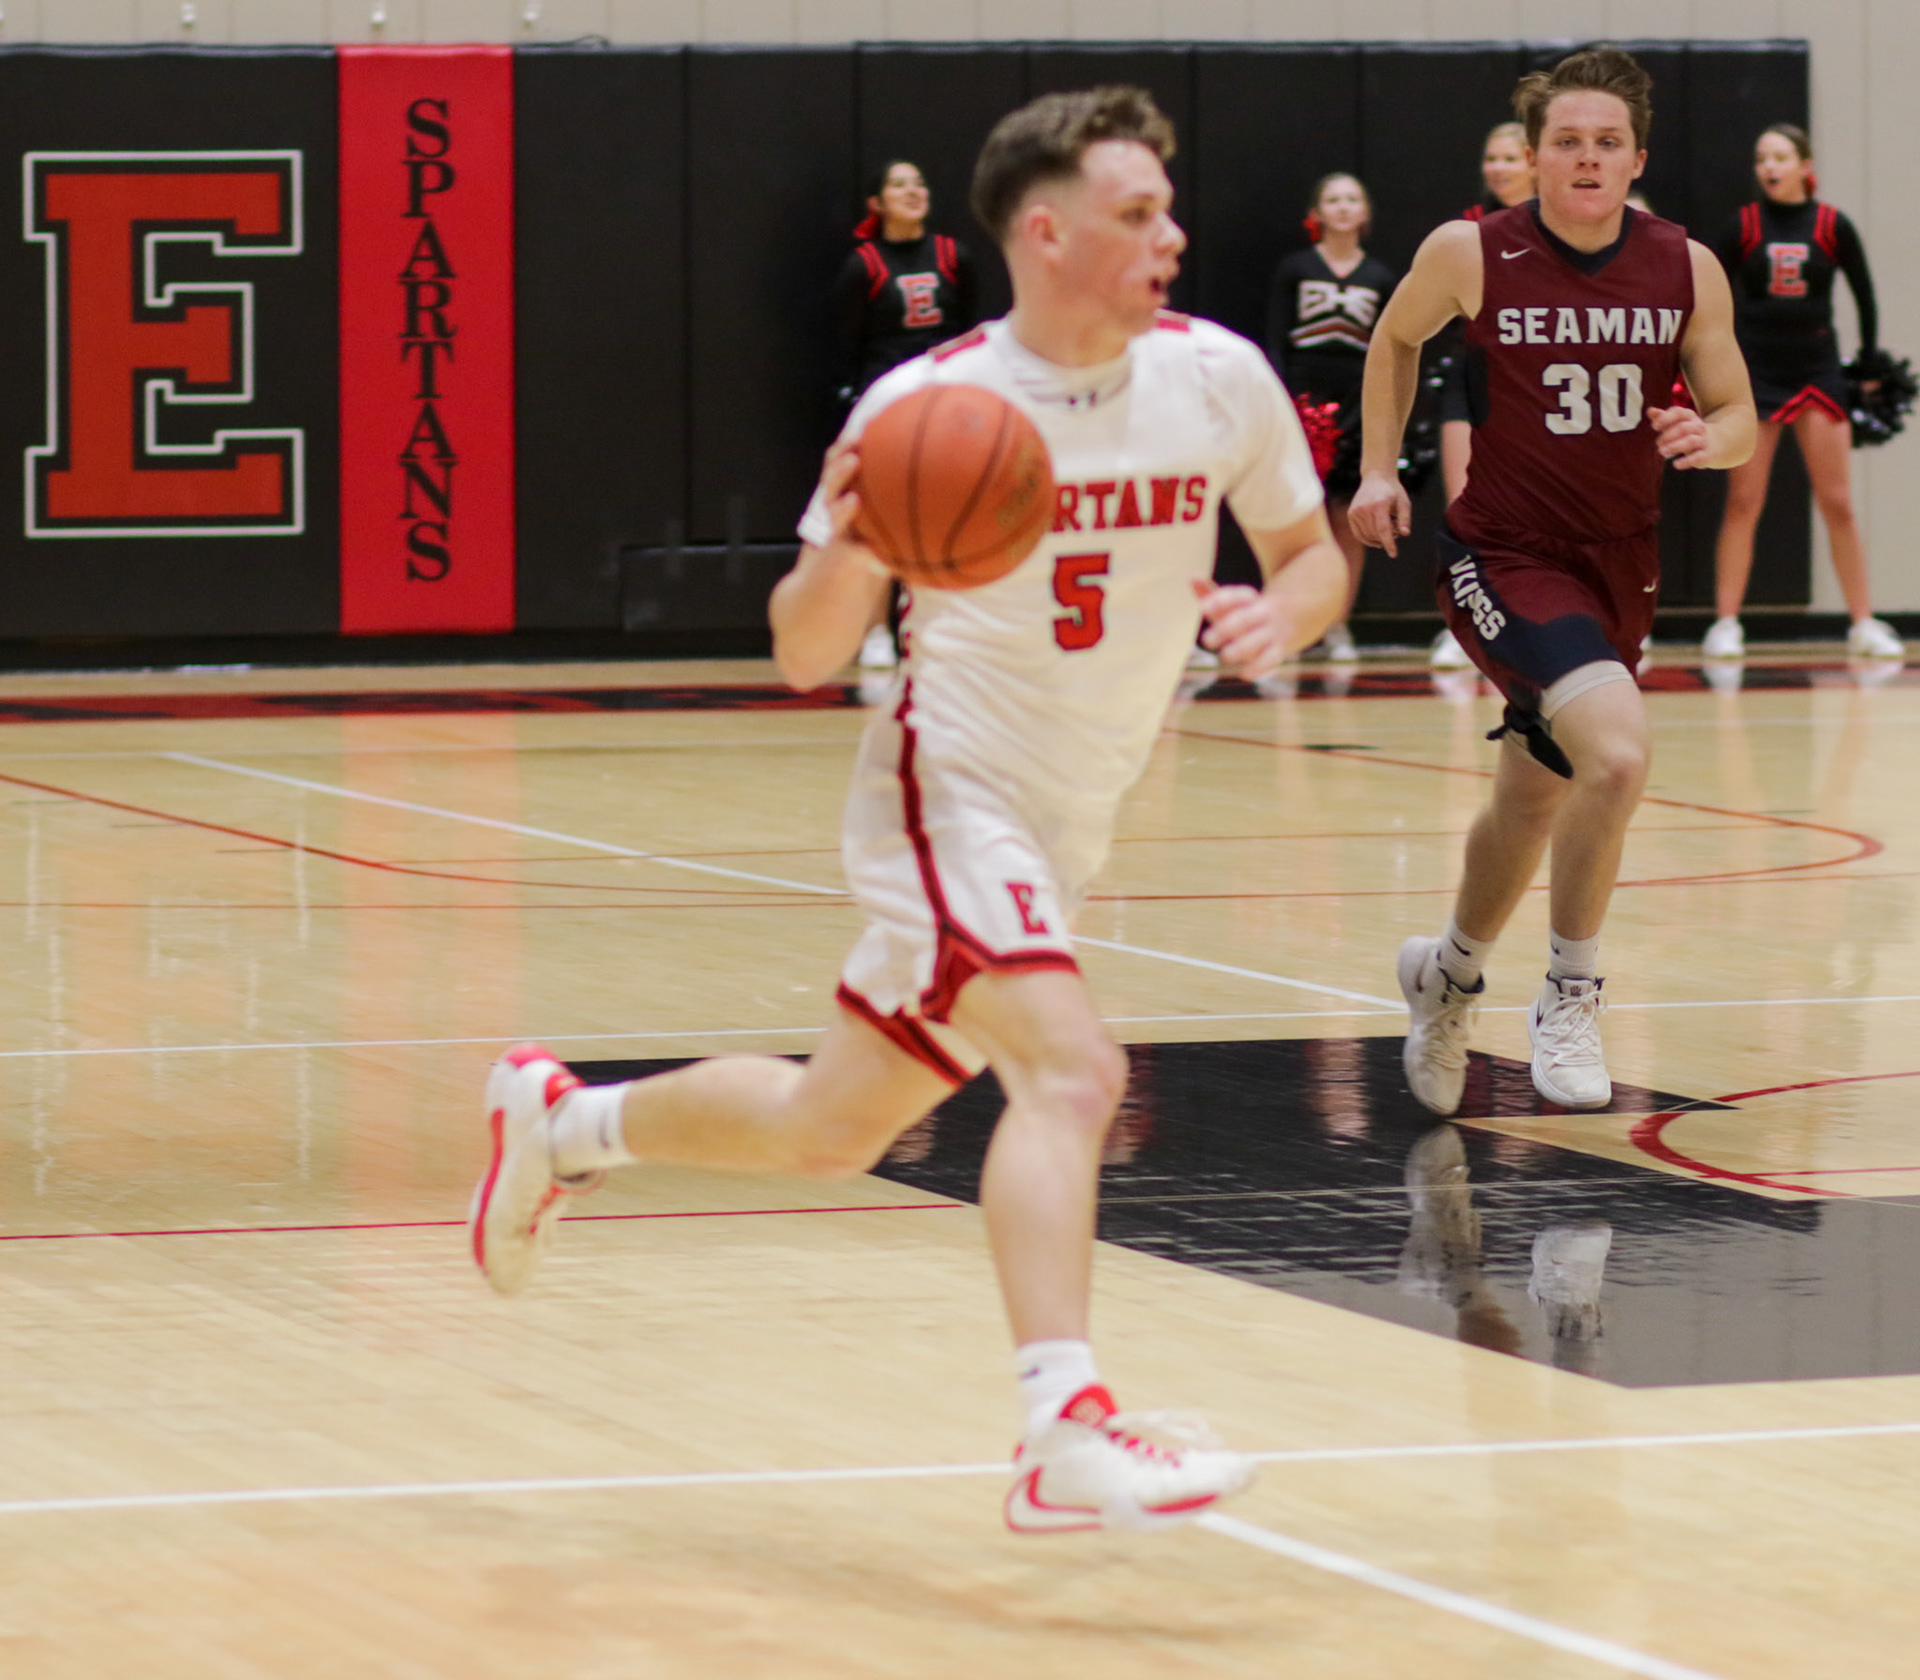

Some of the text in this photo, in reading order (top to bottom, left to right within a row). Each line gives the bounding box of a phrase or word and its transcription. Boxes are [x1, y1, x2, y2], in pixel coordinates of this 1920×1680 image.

[1767, 243, 1808, 296] E
[896, 272, 942, 327] E
[1497, 307, 1683, 345] SEAMAN
[24, 150, 303, 538] E
[399, 98, 457, 582] SPARTANS
[1542, 363, 1644, 435] 30
[1051, 475, 1207, 532] RTANS
[1052, 552, 1110, 651] 5
[1005, 881, 1049, 935] E
